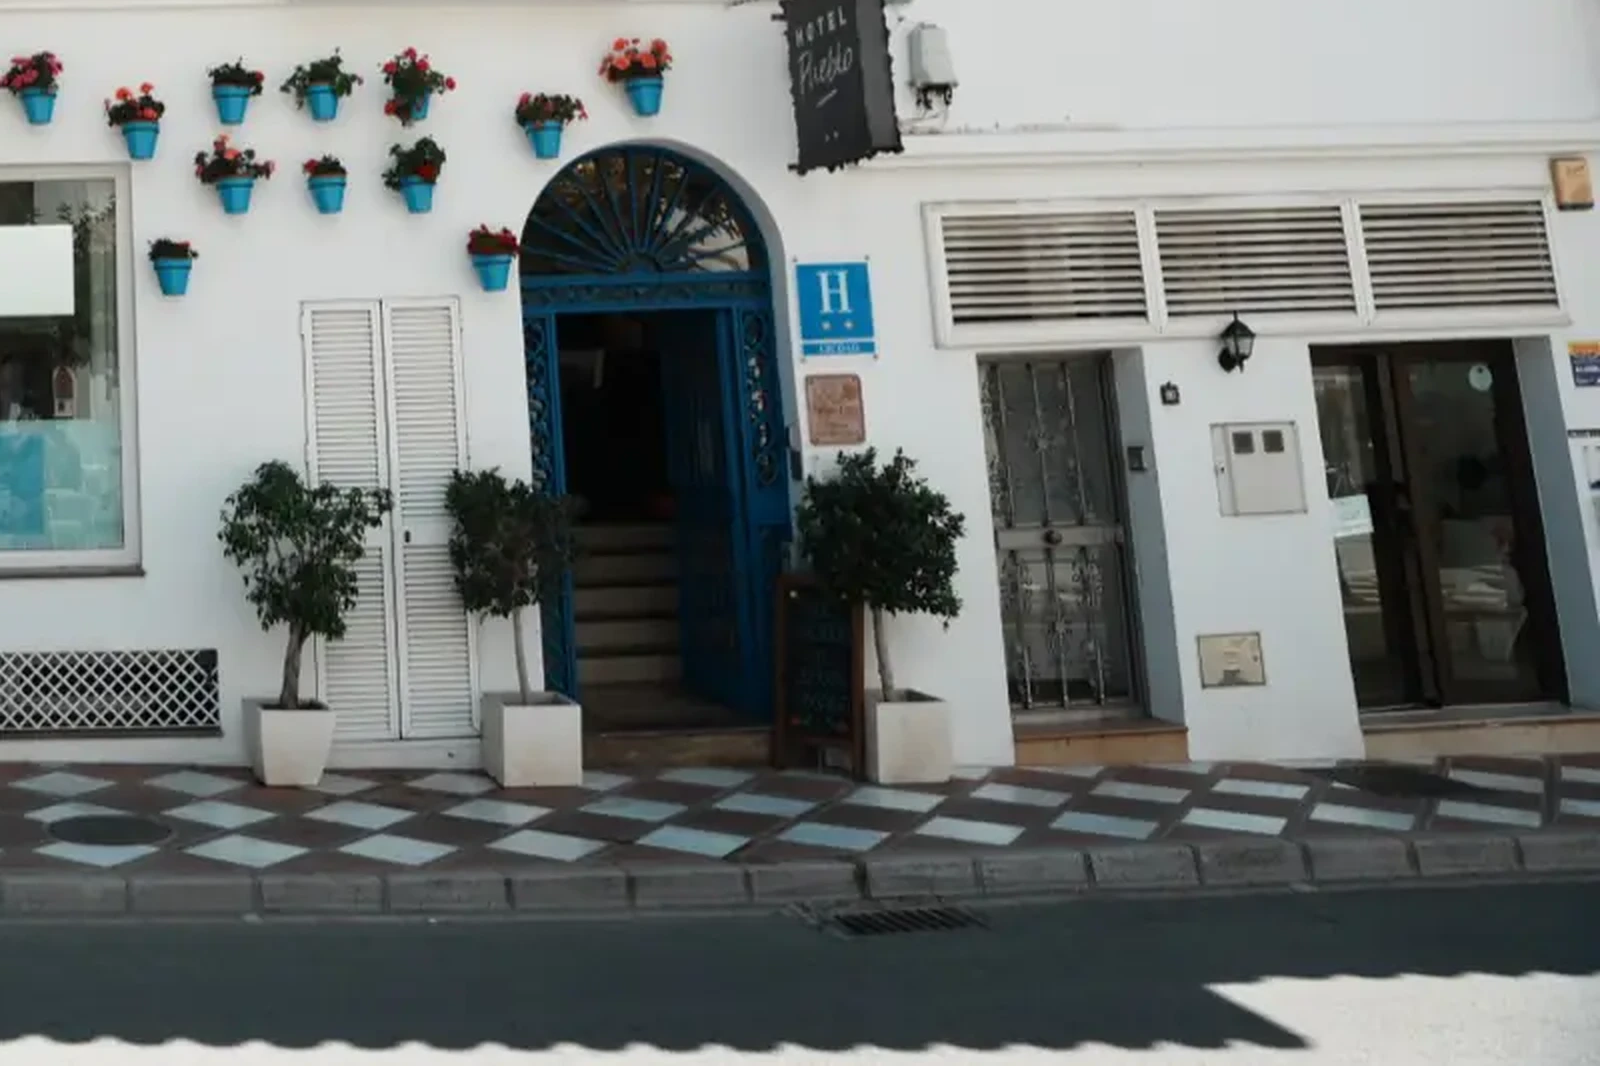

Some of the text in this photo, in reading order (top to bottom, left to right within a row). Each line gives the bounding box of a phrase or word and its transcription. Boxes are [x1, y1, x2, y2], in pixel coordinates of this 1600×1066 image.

[795, 5, 847, 48] HOTEL
[798, 41, 853, 95] Pueblo
[816, 270, 852, 314] H
